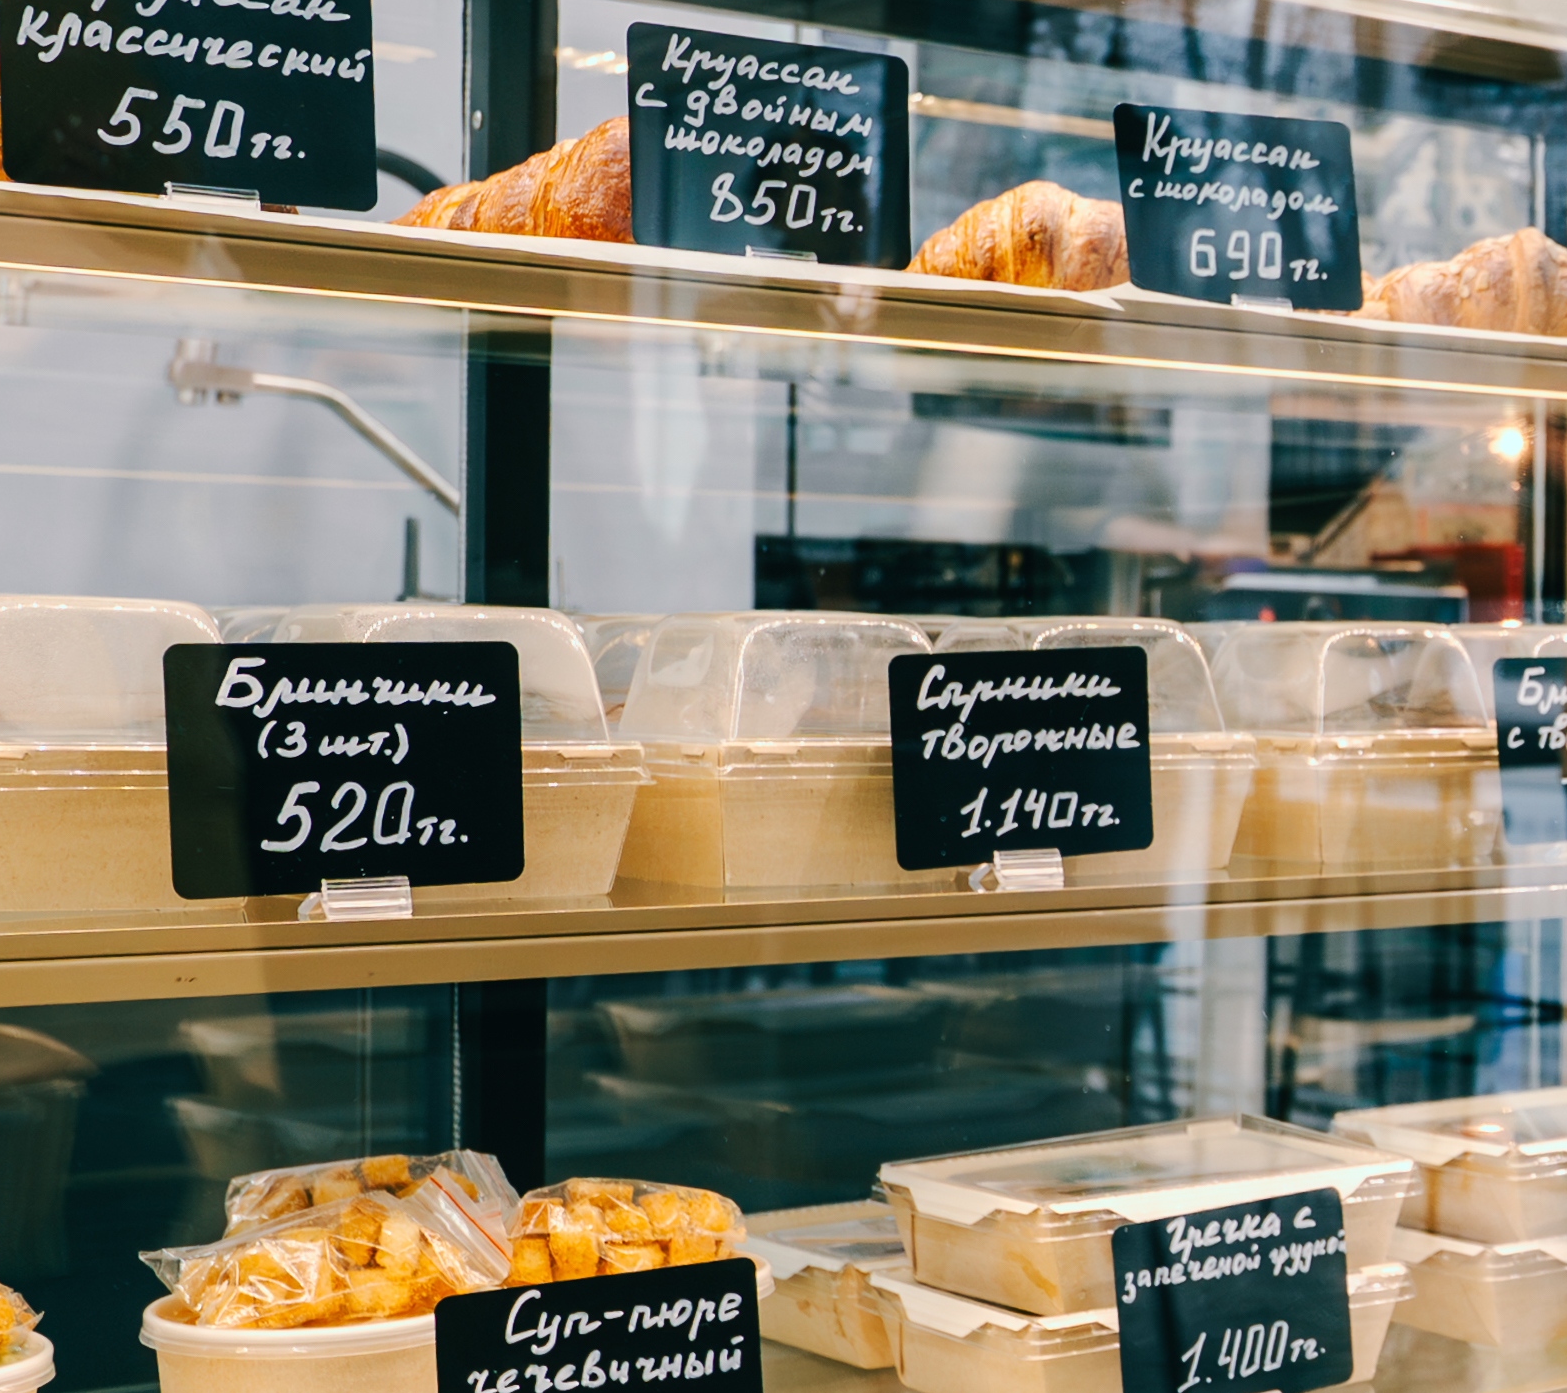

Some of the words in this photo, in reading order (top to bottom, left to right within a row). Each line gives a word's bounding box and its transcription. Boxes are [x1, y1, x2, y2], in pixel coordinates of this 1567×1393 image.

[661, 32, 861, 95] Круассан
[682, 83, 873, 138] двойным
[663, 123, 874, 178] шоколадом
[1141, 111, 1321, 176] Круассан
[1154, 180, 1340, 221] шоколадом
[214, 656, 497, 719] Блинчики
[916, 663, 1122, 724] Сырники
[921, 722, 1141, 770] творожные
[1165, 1211, 1282, 1264] Гречка
[504, 1288, 743, 1357] Суп-пюре
